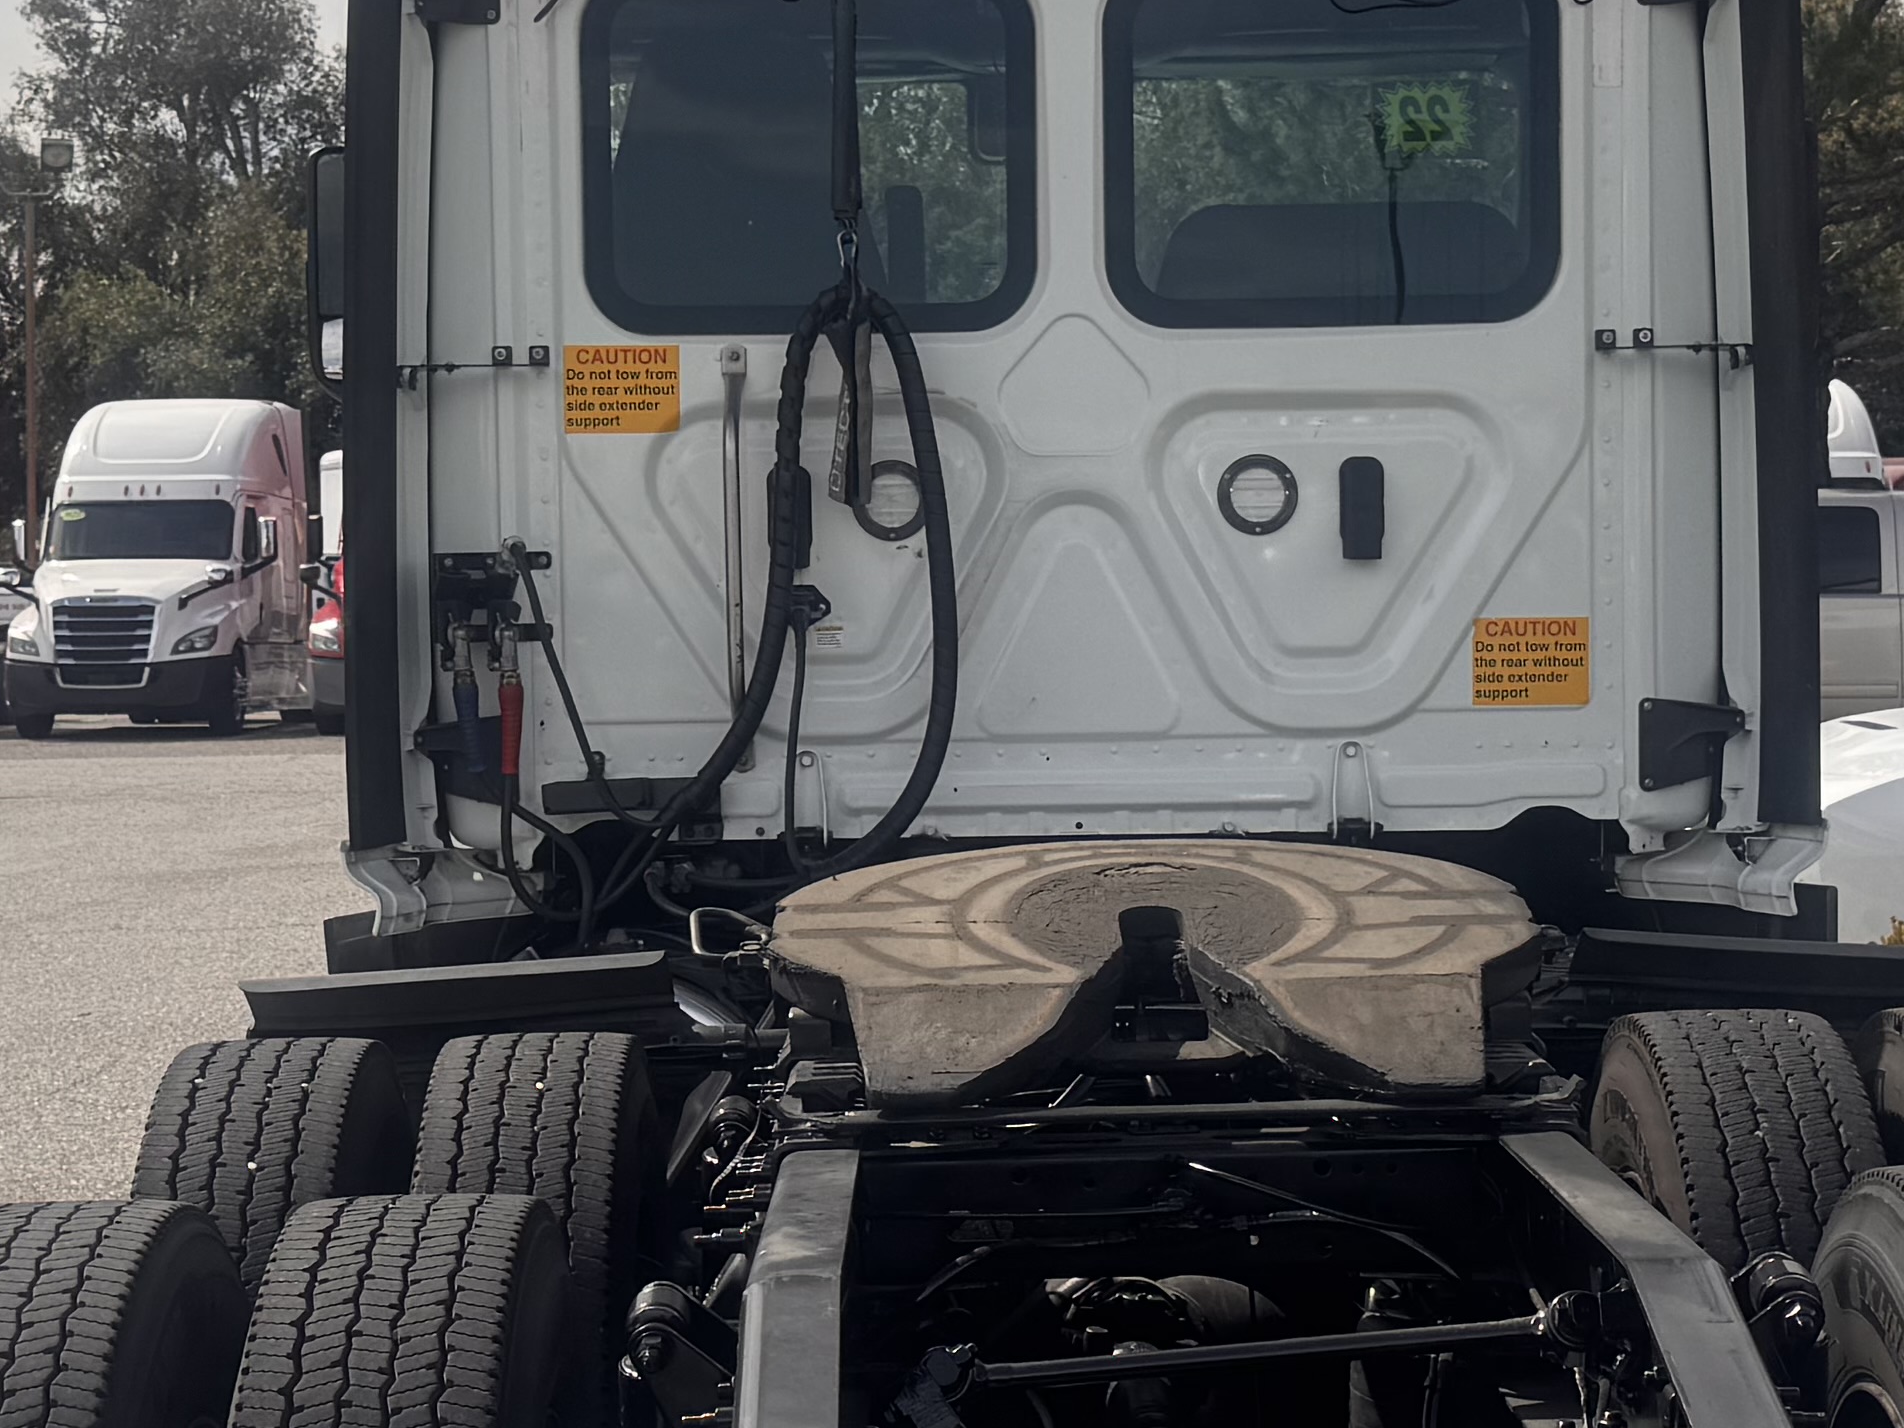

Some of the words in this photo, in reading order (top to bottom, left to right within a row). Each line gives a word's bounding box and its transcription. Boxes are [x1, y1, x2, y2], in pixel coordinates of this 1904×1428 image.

[576, 348, 667, 365] CAUTION
[566, 369, 585, 380] Do
[589, 369, 611, 380] not
[615, 369, 641, 380] tow
[645, 368, 678, 380] from
[566, 384, 587, 396] the
[592, 385, 619, 396] rear
[624, 384, 675, 395] without
[566, 400, 595, 411] side
[599, 400, 660, 411] extender
[566, 416, 621, 429] support
[1485, 620, 1576, 637] CAUTION
[1475, 641, 1494, 652] Do
[1498, 641, 1521, 652] not
[1525, 641, 1550, 652] tow
[1554, 640, 1586, 651] from
[1474, 656, 1496, 667] the
[1501, 657, 1528, 667] rear
[1532, 655, 1584, 667] without
[1474, 672, 1504, 683] side
[1508, 671, 1569, 682] extender
[1474, 687, 1529, 701] support
